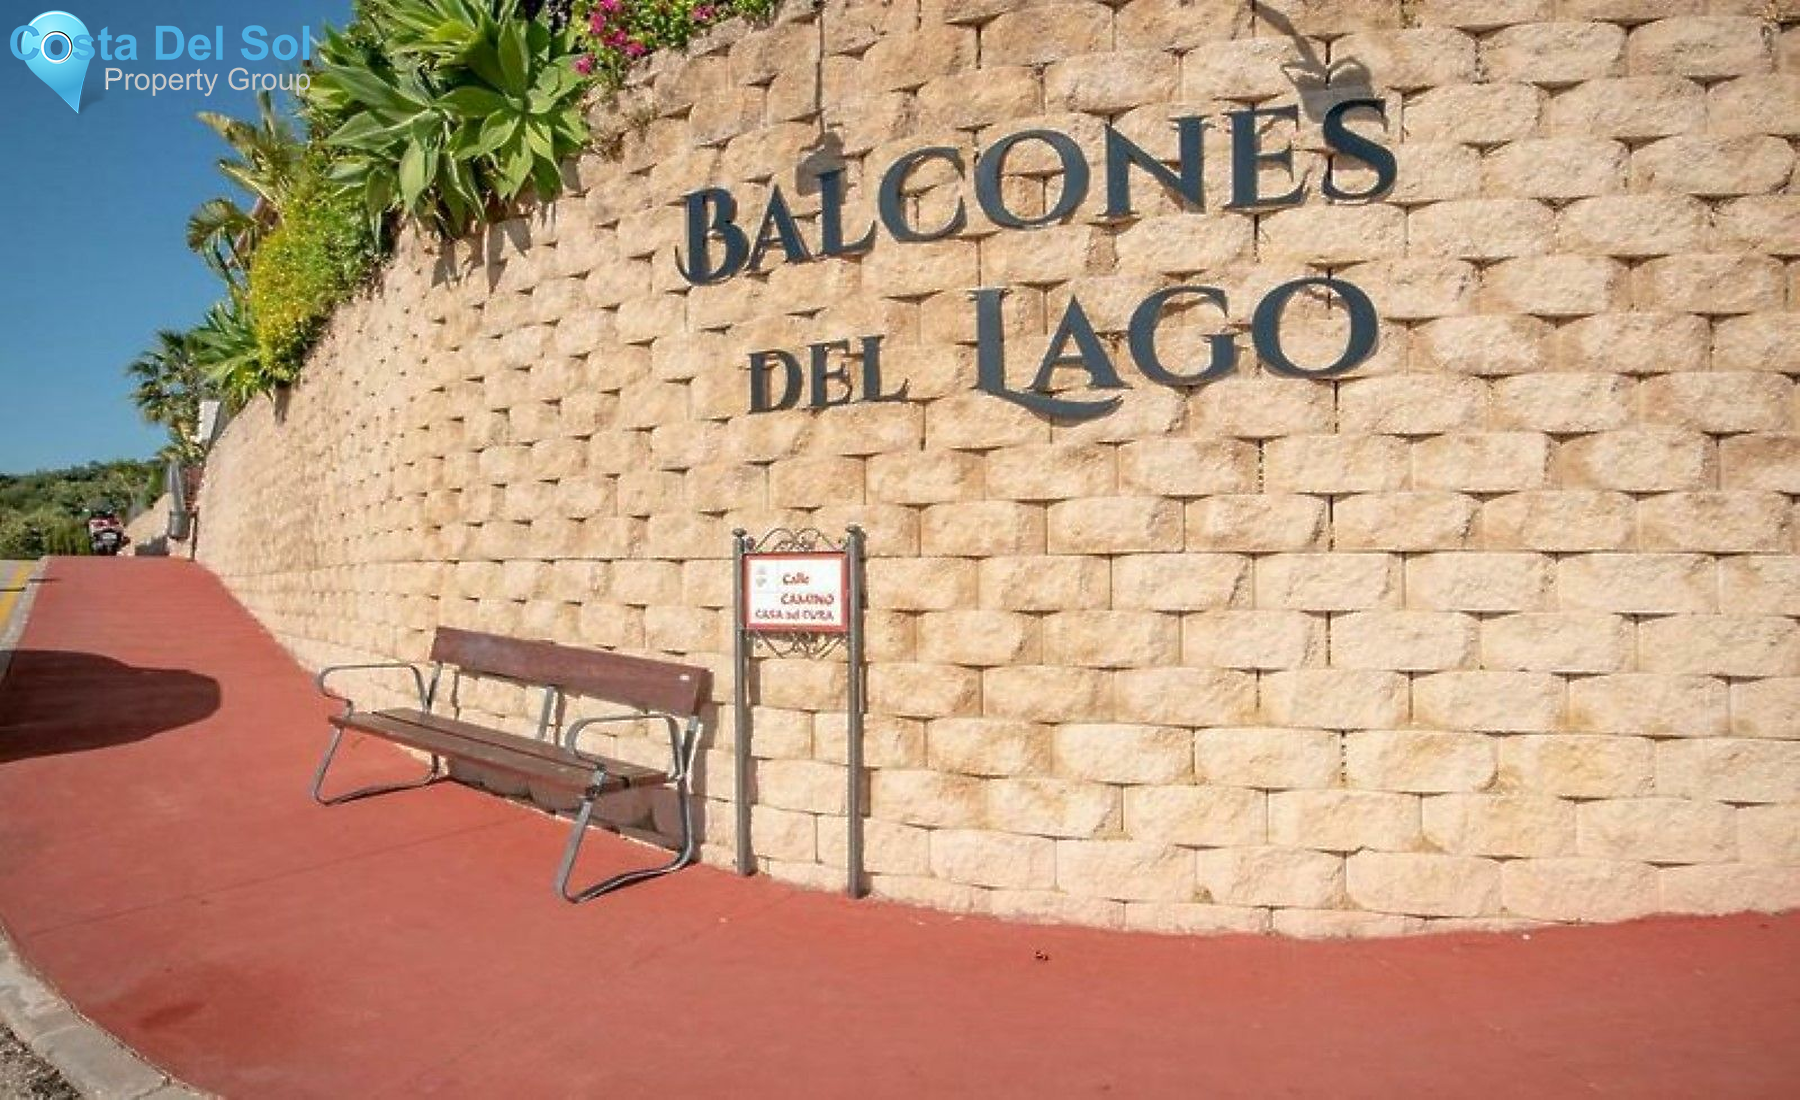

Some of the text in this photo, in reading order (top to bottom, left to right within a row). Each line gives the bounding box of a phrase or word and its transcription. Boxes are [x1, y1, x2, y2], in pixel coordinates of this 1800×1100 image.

[675, 98, 1398, 286] BALCONES
[747, 277, 1380, 420] DEL LAGO
[780, 592, 835, 605] CAMINO
